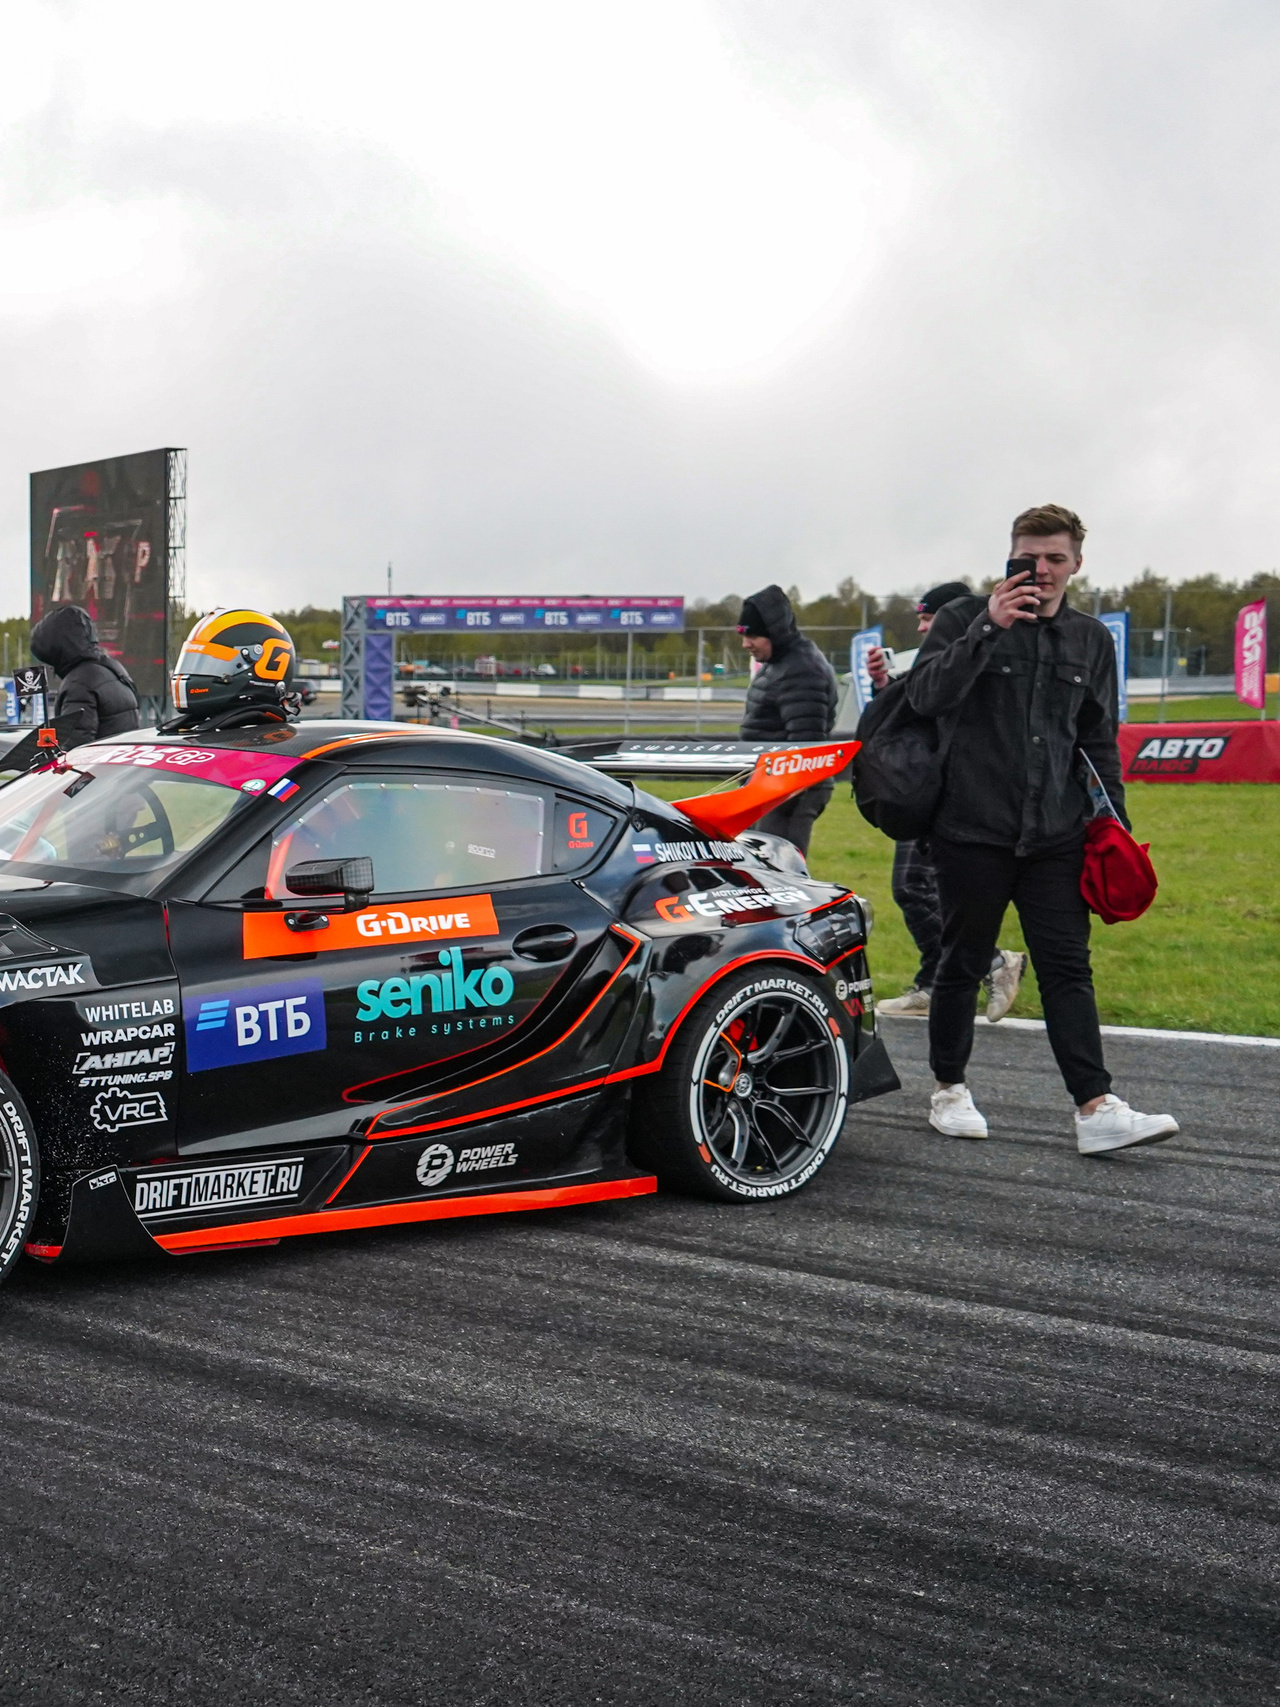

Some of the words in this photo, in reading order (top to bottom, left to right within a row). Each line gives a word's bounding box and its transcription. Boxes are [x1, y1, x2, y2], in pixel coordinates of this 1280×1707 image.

[1138, 738, 1225, 759] АВТО
[655, 841, 700, 862] SHIKOV
[356, 946, 514, 1022] seniko
[85, 999, 174, 1022] WHITELAB
[235, 996, 311, 1047] ВТБ
[81, 1023, 175, 1046] WRAPCAR
[354, 1026, 416, 1043] Brake
[431, 1015, 515, 1035] systems
[79, 1070, 173, 1087] STTUNING.SPB
[104, 1100, 157, 1121] VRC
[459, 1142, 515, 1161] POWER
[456, 1154, 518, 1173] WHEELS
[135, 1164, 304, 1211] DRIFTMARKET.RU
